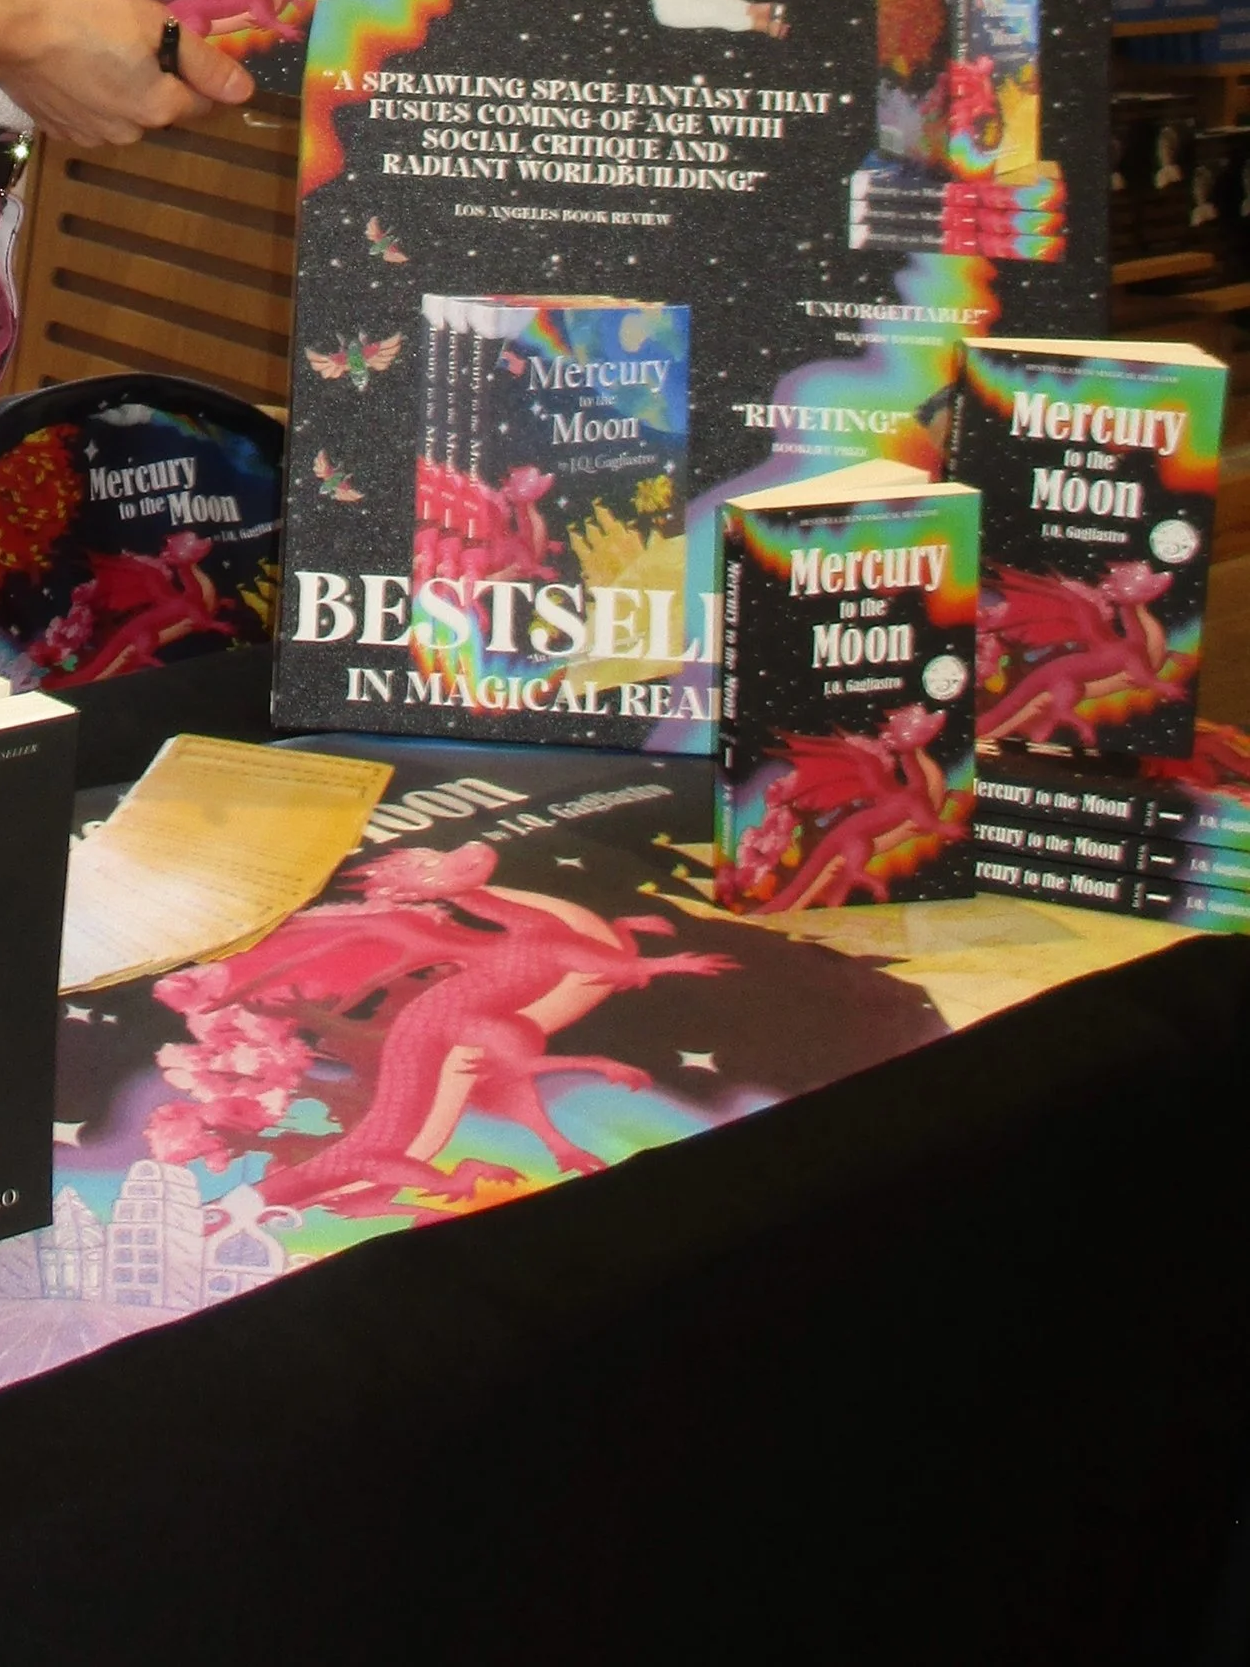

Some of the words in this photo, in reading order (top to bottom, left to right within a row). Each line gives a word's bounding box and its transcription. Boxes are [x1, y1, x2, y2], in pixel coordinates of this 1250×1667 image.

[362, 71, 526, 100] SPRAWLING
[756, 89, 833, 114] THAT
[369, 98, 472, 124] FUSUES
[709, 114, 784, 139] WITH
[422, 128, 526, 154] SOCIAL
[532, 133, 660, 163] CRITIQUE
[667, 140, 729, 163] AND
[382, 153, 510, 180] RADIANT
[455, 203, 485, 217] LOS
[488, 205, 559, 221] ANGELES
[562, 208, 608, 223] BOOK
[611, 211, 672, 227] REVIEW
[528, 354, 670, 394] Mercury
[579, 395, 594, 407] to
[596, 394, 618, 406] the
[552, 410, 640, 445] Moon
[1008, 390, 1188, 457] Mercury
[1063, 448, 1084, 468] to
[1086, 450, 1117, 471] the
[89, 456, 198, 502] Mercury
[1030, 467, 1143, 519] Moon
[118, 502, 136, 521] to
[138, 496, 167, 519] the
[166, 491, 242, 526] Moon
[1065, 525, 1130, 544] Gagliastro
[788, 543, 948, 598] Mercury
[725, 560, 743, 627] Mercury
[839, 600, 856, 620] to
[860, 597, 887, 618] the
[725, 629, 738, 645] to
[811, 622, 912, 669] Moon
[724, 646, 738, 671] the
[346, 666, 394, 706] IN
[404, 671, 613, 718] MAGICAL
[723, 674, 739, 720] Moon
[845, 677, 903, 695] Gagliastro
[350, 777, 530, 855] oon
[547, 784, 675, 819] Gagliastro
[1035, 790, 1051, 806] to
[1053, 792, 1077, 809] the
[1081, 793, 1132, 819] Moon
[1027, 832, 1043, 849] to
[1046, 834, 1071, 852] the
[1073, 836, 1124, 862] Moon
[1023, 869, 1040, 886] to
[1042, 871, 1067, 891] the
[1069, 874, 1120, 900] Moon
